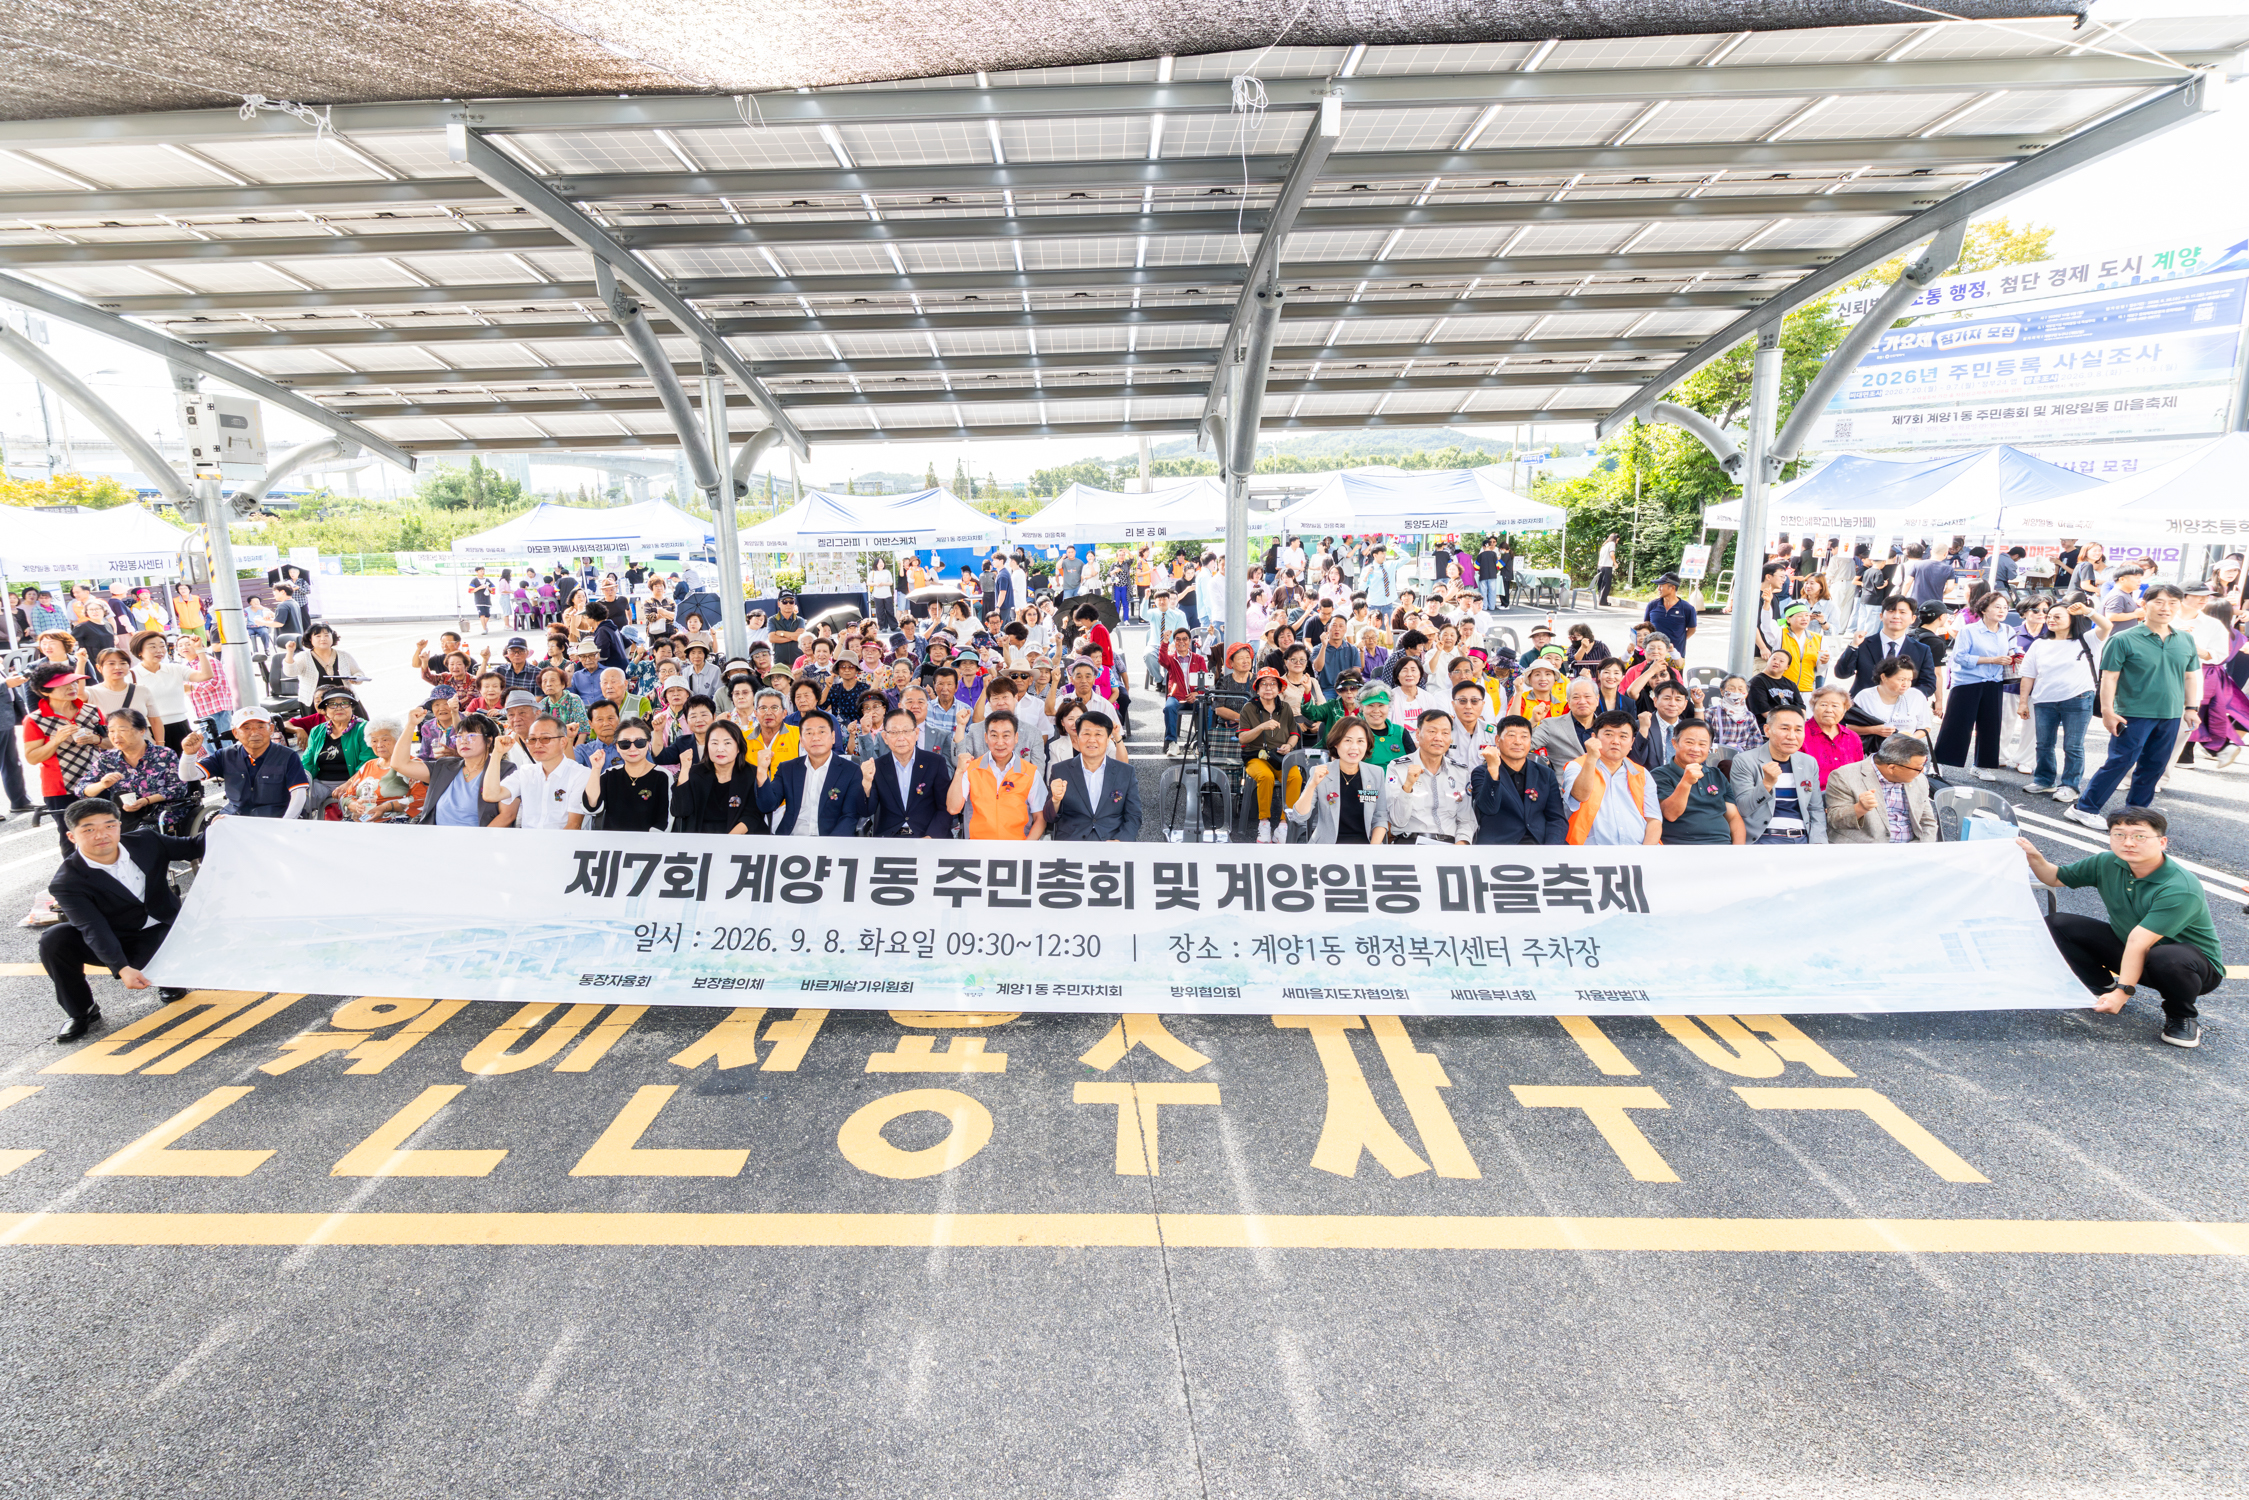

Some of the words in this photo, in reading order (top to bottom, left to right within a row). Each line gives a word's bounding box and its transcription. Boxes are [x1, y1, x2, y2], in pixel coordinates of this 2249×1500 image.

[1949, 280, 1991, 302] 행정,
[2000, 272, 2040, 294] 첨단
[2048, 264, 2090, 287] 경제
[2098, 255, 2144, 279] 도시
[2151, 246, 2203, 270] 계양
[1883, 332, 1935, 352] 가요제
[1987, 325, 2016, 340] 모집
[1861, 366, 1939, 388] 2026년
[1948, 355, 2041, 381] 주민등록
[2053, 343, 2163, 371] 사실조사
[1891, 413, 1924, 426] 제7회
[1927, 410, 1973, 424] 계양1동
[1976, 406, 2030, 421] 주민총회
[2033, 405, 2047, 418] 및
[2050, 400, 2109, 416] 계양일동
[2113, 396, 2178, 412] 마을축제
[2101, 458, 2138, 473] 모집
[1125, 527, 1167, 537] 리본공예
[1404, 519, 1448, 529] 동양도서관
[527, 545, 551, 554] 아모르
[873, 536, 917, 546] 어반스케치
[108, 559, 164, 572] 자원봉사센터
[564, 850, 712, 902] 제7회
[725, 854, 919, 907] 계양1동
[933, 858, 1133, 910] 주민총회
[1151, 861, 1201, 911] 및
[1216, 862, 1422, 915] 계양일동
[1436, 863, 1651, 915] 마을축제
[633, 922, 683, 953] 일시
[710, 926, 778, 953] 2026.
[791, 928, 811, 953] 9.
[824, 929, 845, 953] 8.
[857, 927, 936, 959] 화요일
[947, 931, 1101, 959] 09:30~12:30
[1168, 933, 1222, 964] 장소
[1251, 934, 1346, 967] 계양1동
[1355, 933, 1510, 968] 행정복지센터
[1521, 935, 1601, 969] 주차장
[578, 973, 652, 988] 통장자율회
[692, 976, 765, 991] 보장협의체
[800, 978, 914, 994] 바르게살기위원회
[996, 983, 1048, 996] 계양1동
[1052, 984, 1123, 997] 주민자치회
[1170, 986, 1241, 1000] 방위협의회
[1281, 987, 1409, 1001] 새마을지도자협의회
[1450, 988, 1536, 1002] 새마을부녀회
[1574, 988, 1650, 1002] 자율방범대
